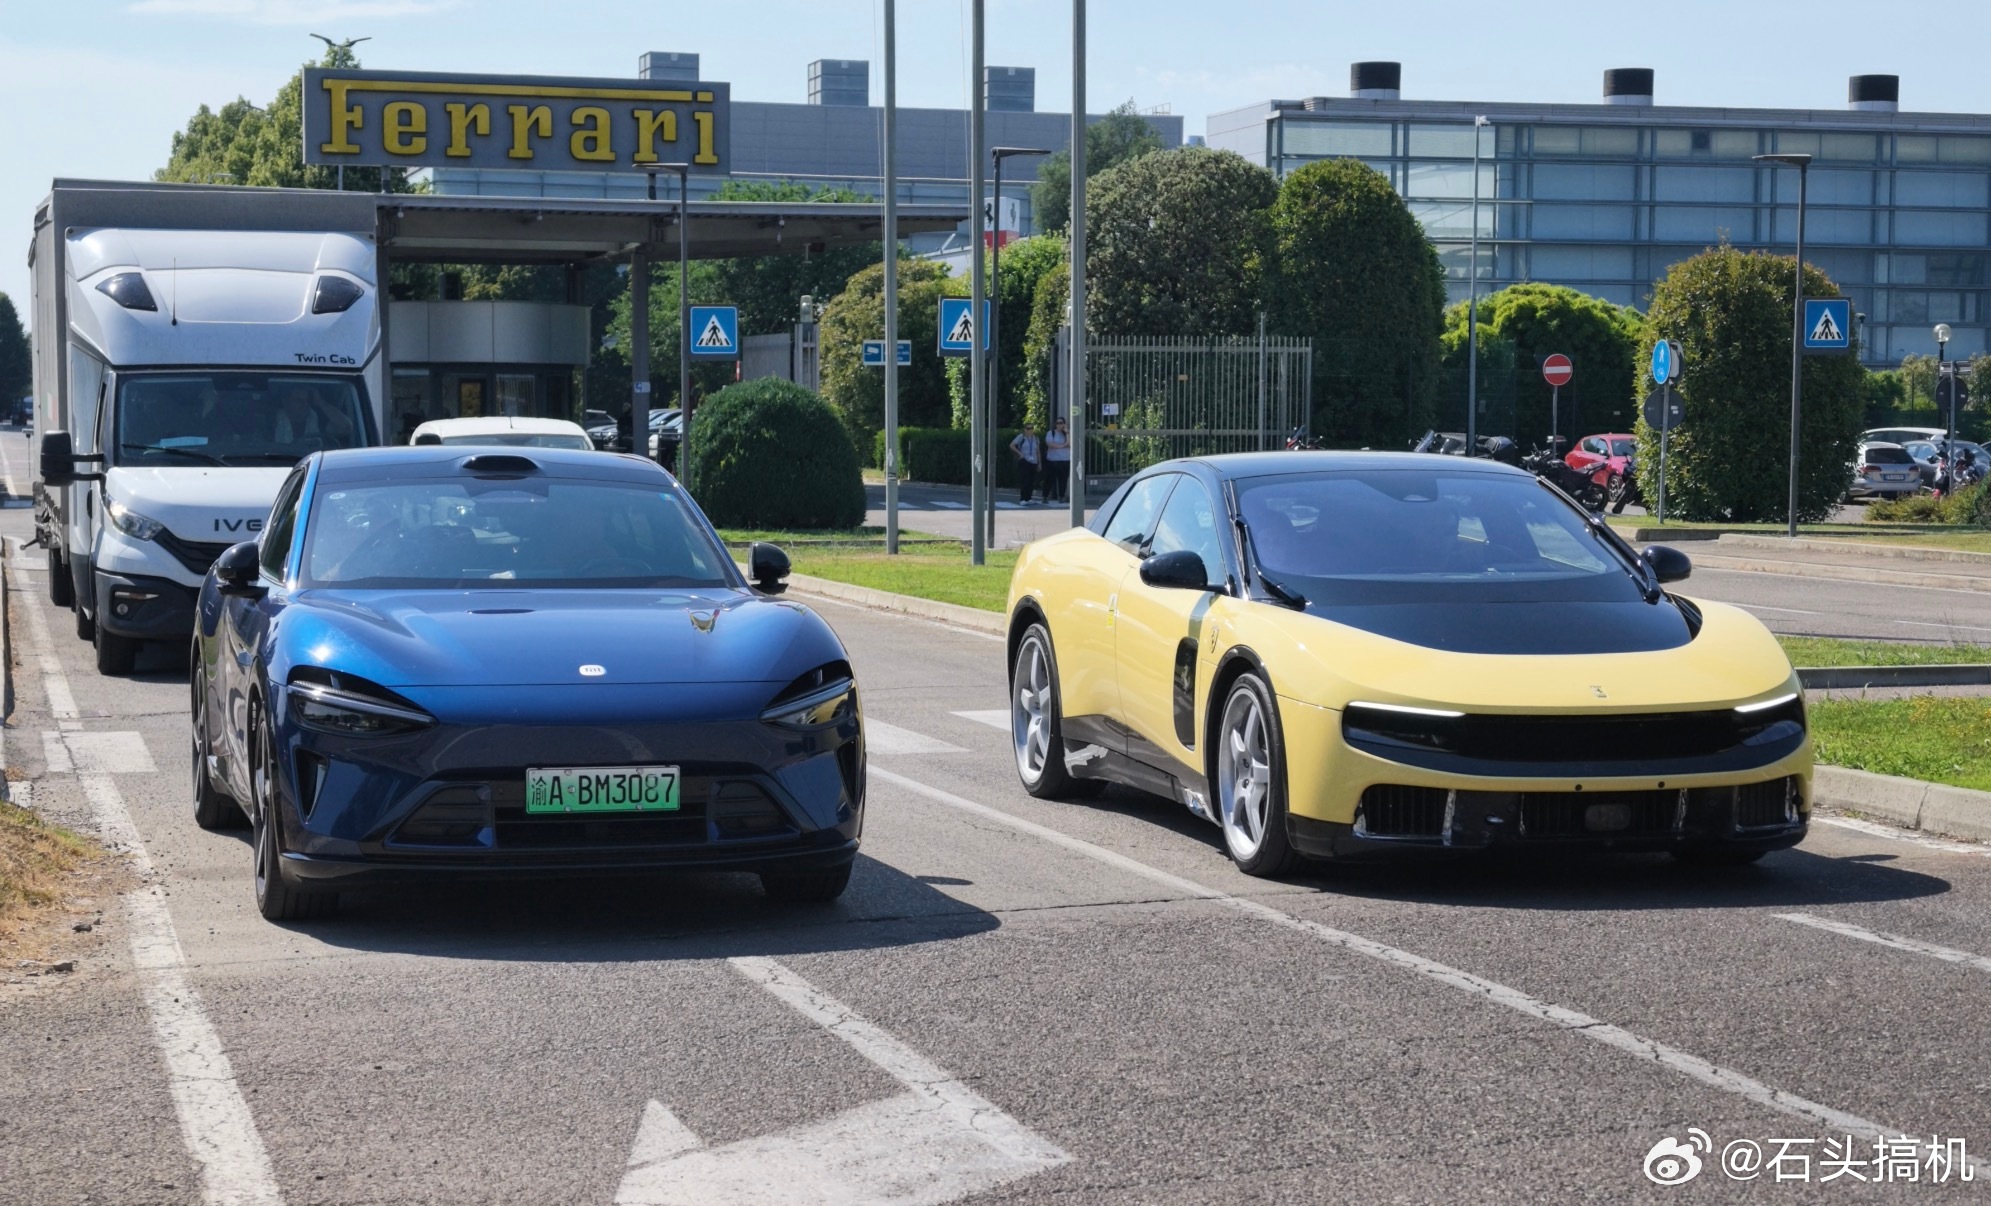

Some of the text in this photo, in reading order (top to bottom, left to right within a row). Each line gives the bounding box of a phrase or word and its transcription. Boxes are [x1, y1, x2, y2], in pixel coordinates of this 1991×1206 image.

[321, 78, 719, 165] Ferrari
[294, 353, 356, 365] Twin Cab
[214, 518, 263, 532] IVE
